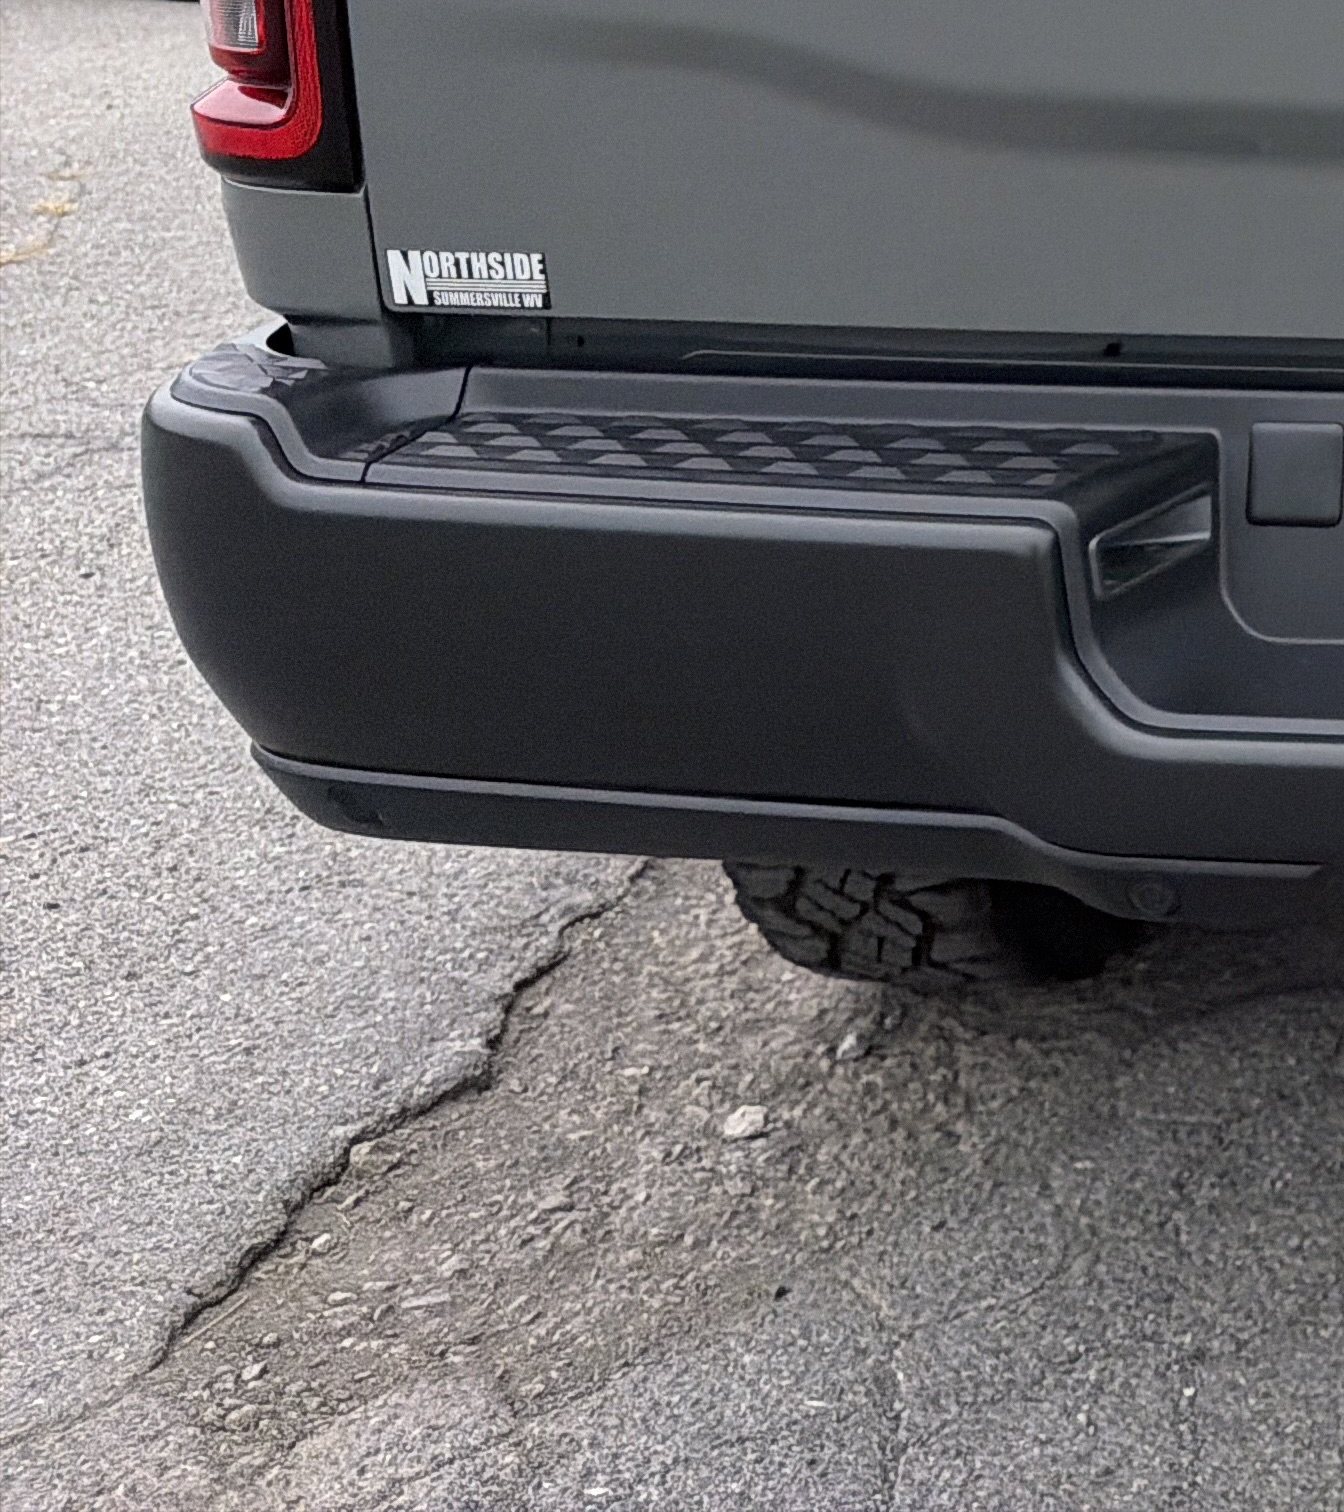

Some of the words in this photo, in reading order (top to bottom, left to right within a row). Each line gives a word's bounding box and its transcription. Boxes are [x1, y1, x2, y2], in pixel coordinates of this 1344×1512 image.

[386, 249, 546, 306] NORTHSIDE
[433, 290, 521, 306] SUMMERSVILLE
[522, 293, 543, 308] WV
